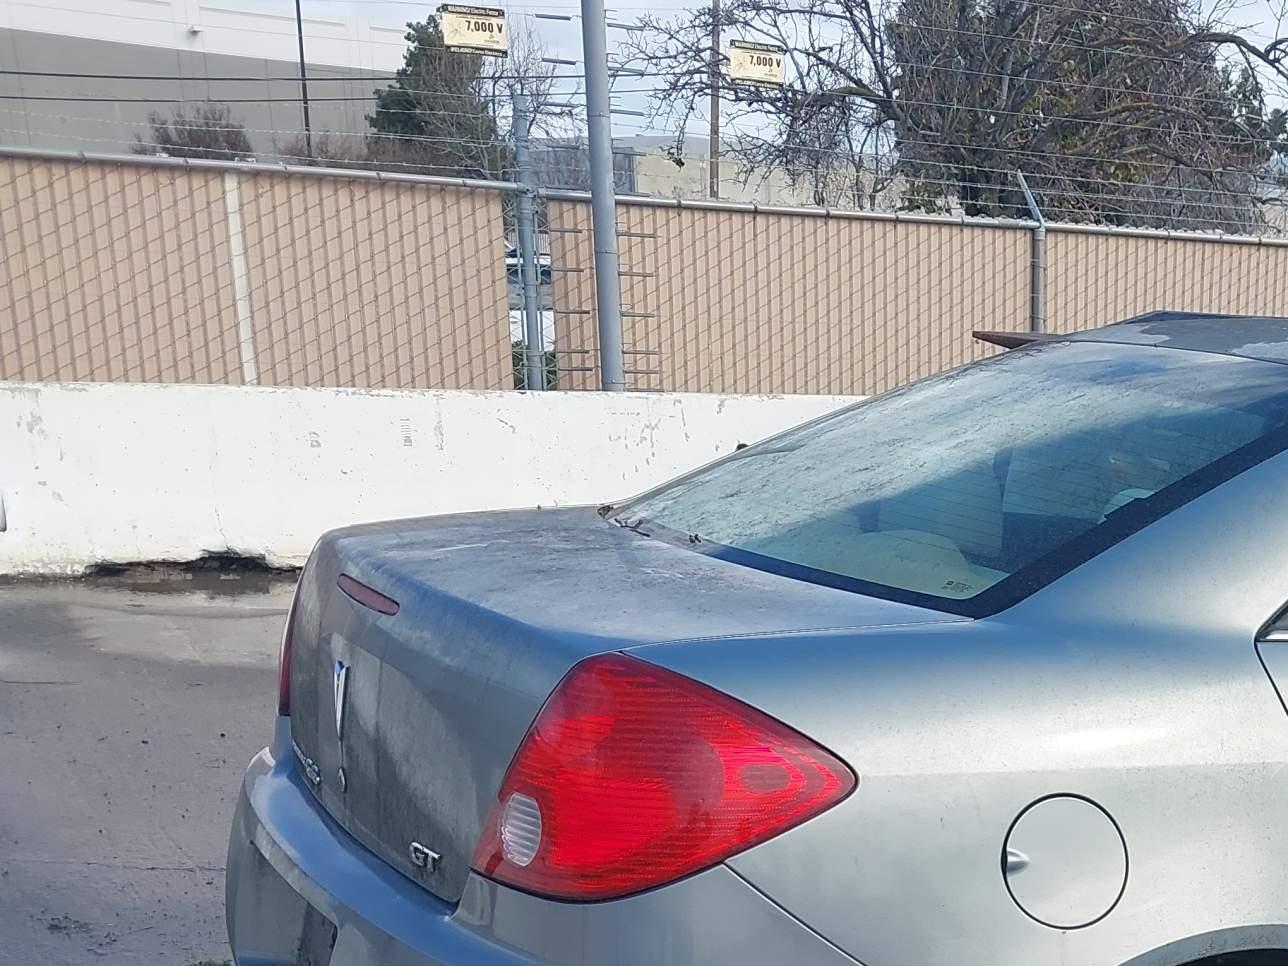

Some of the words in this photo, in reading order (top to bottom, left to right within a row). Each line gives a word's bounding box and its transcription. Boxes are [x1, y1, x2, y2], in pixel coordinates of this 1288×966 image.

[465, 20, 494, 33] 7,000
[497, 23, 503, 34] V
[749, 55, 774, 67] 7,000
[776, 58, 782, 68] V
[408, 841, 441, 872] GT
